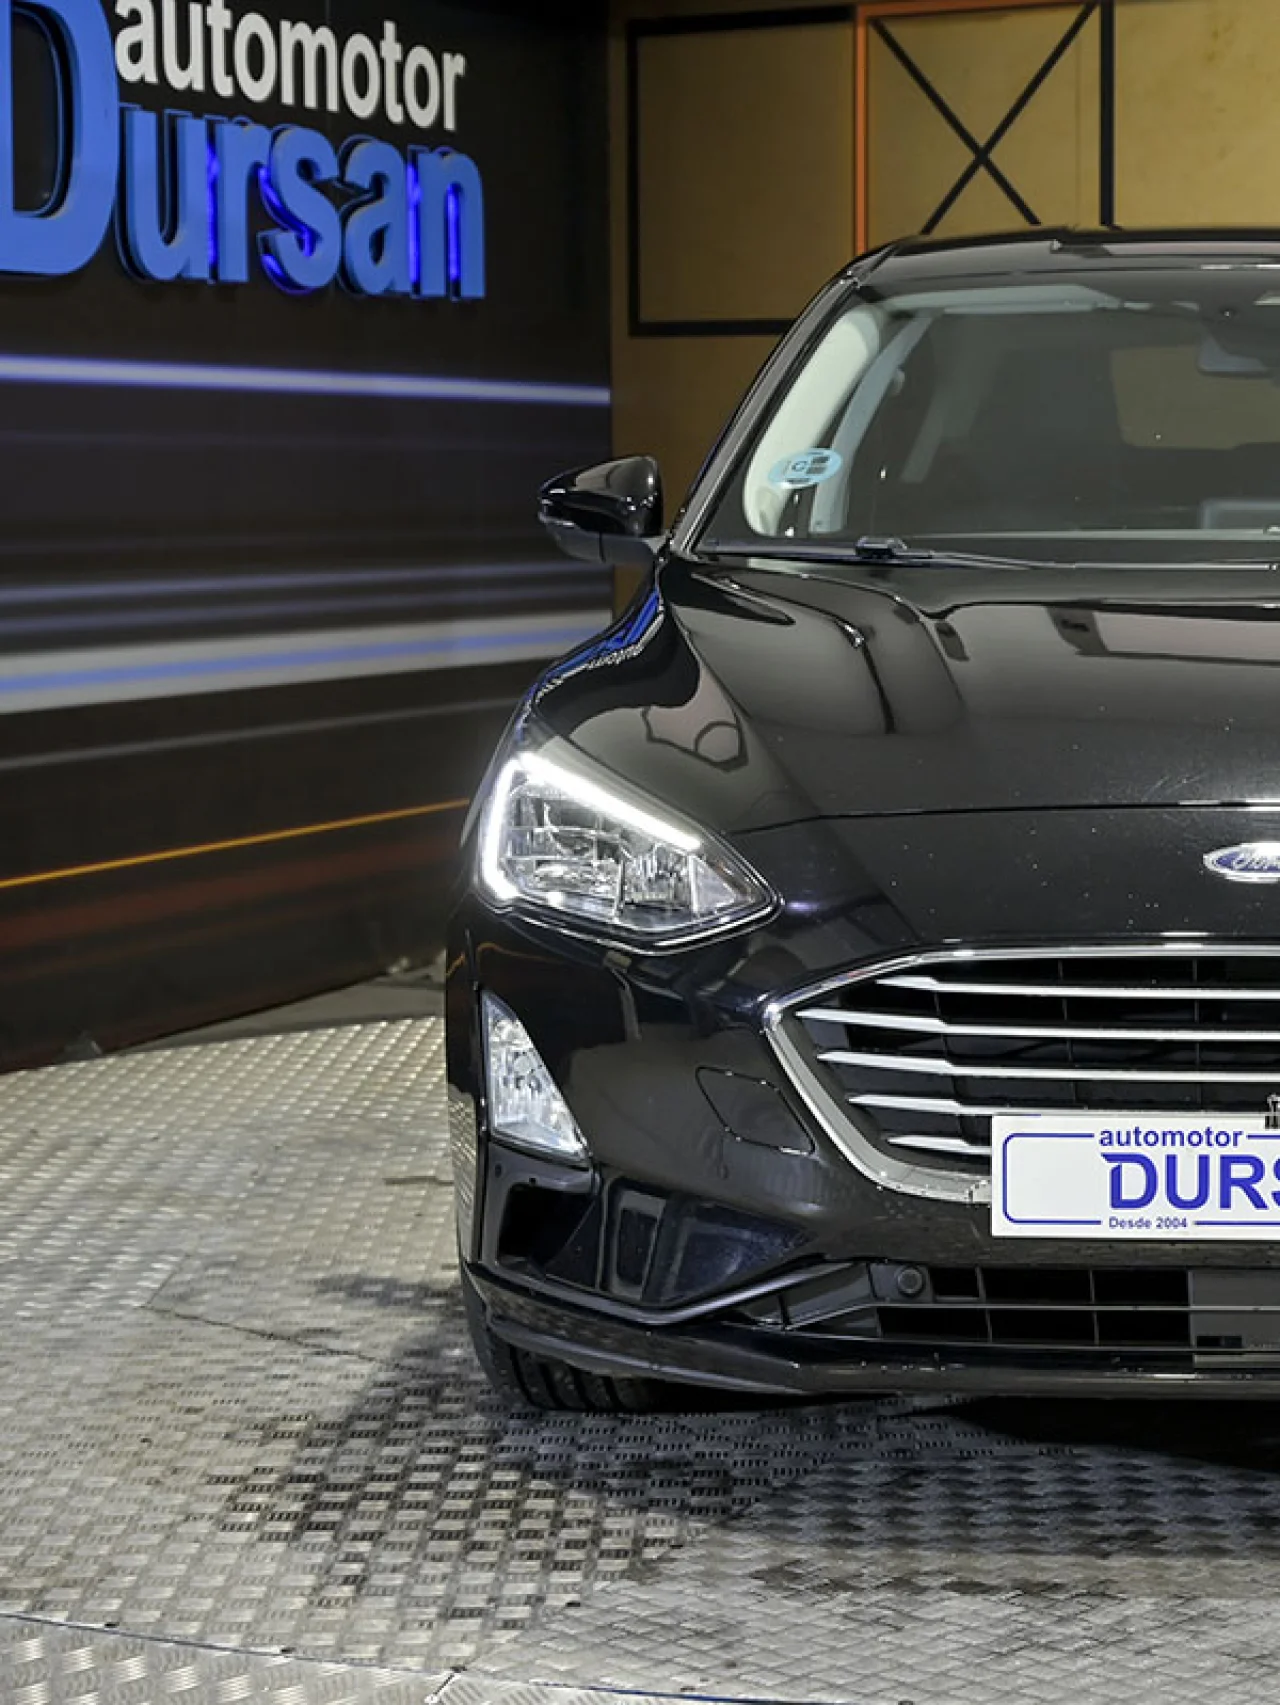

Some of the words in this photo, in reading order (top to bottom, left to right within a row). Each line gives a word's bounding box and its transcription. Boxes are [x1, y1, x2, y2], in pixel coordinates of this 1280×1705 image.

[114, 0, 466, 131] automotor
[0, 0, 486, 299] Dursan
[1099, 1126, 1244, 1147] automotor
[1108, 1216, 1152, 1229] Desde
[1155, 1216, 1188, 1229] 2004
